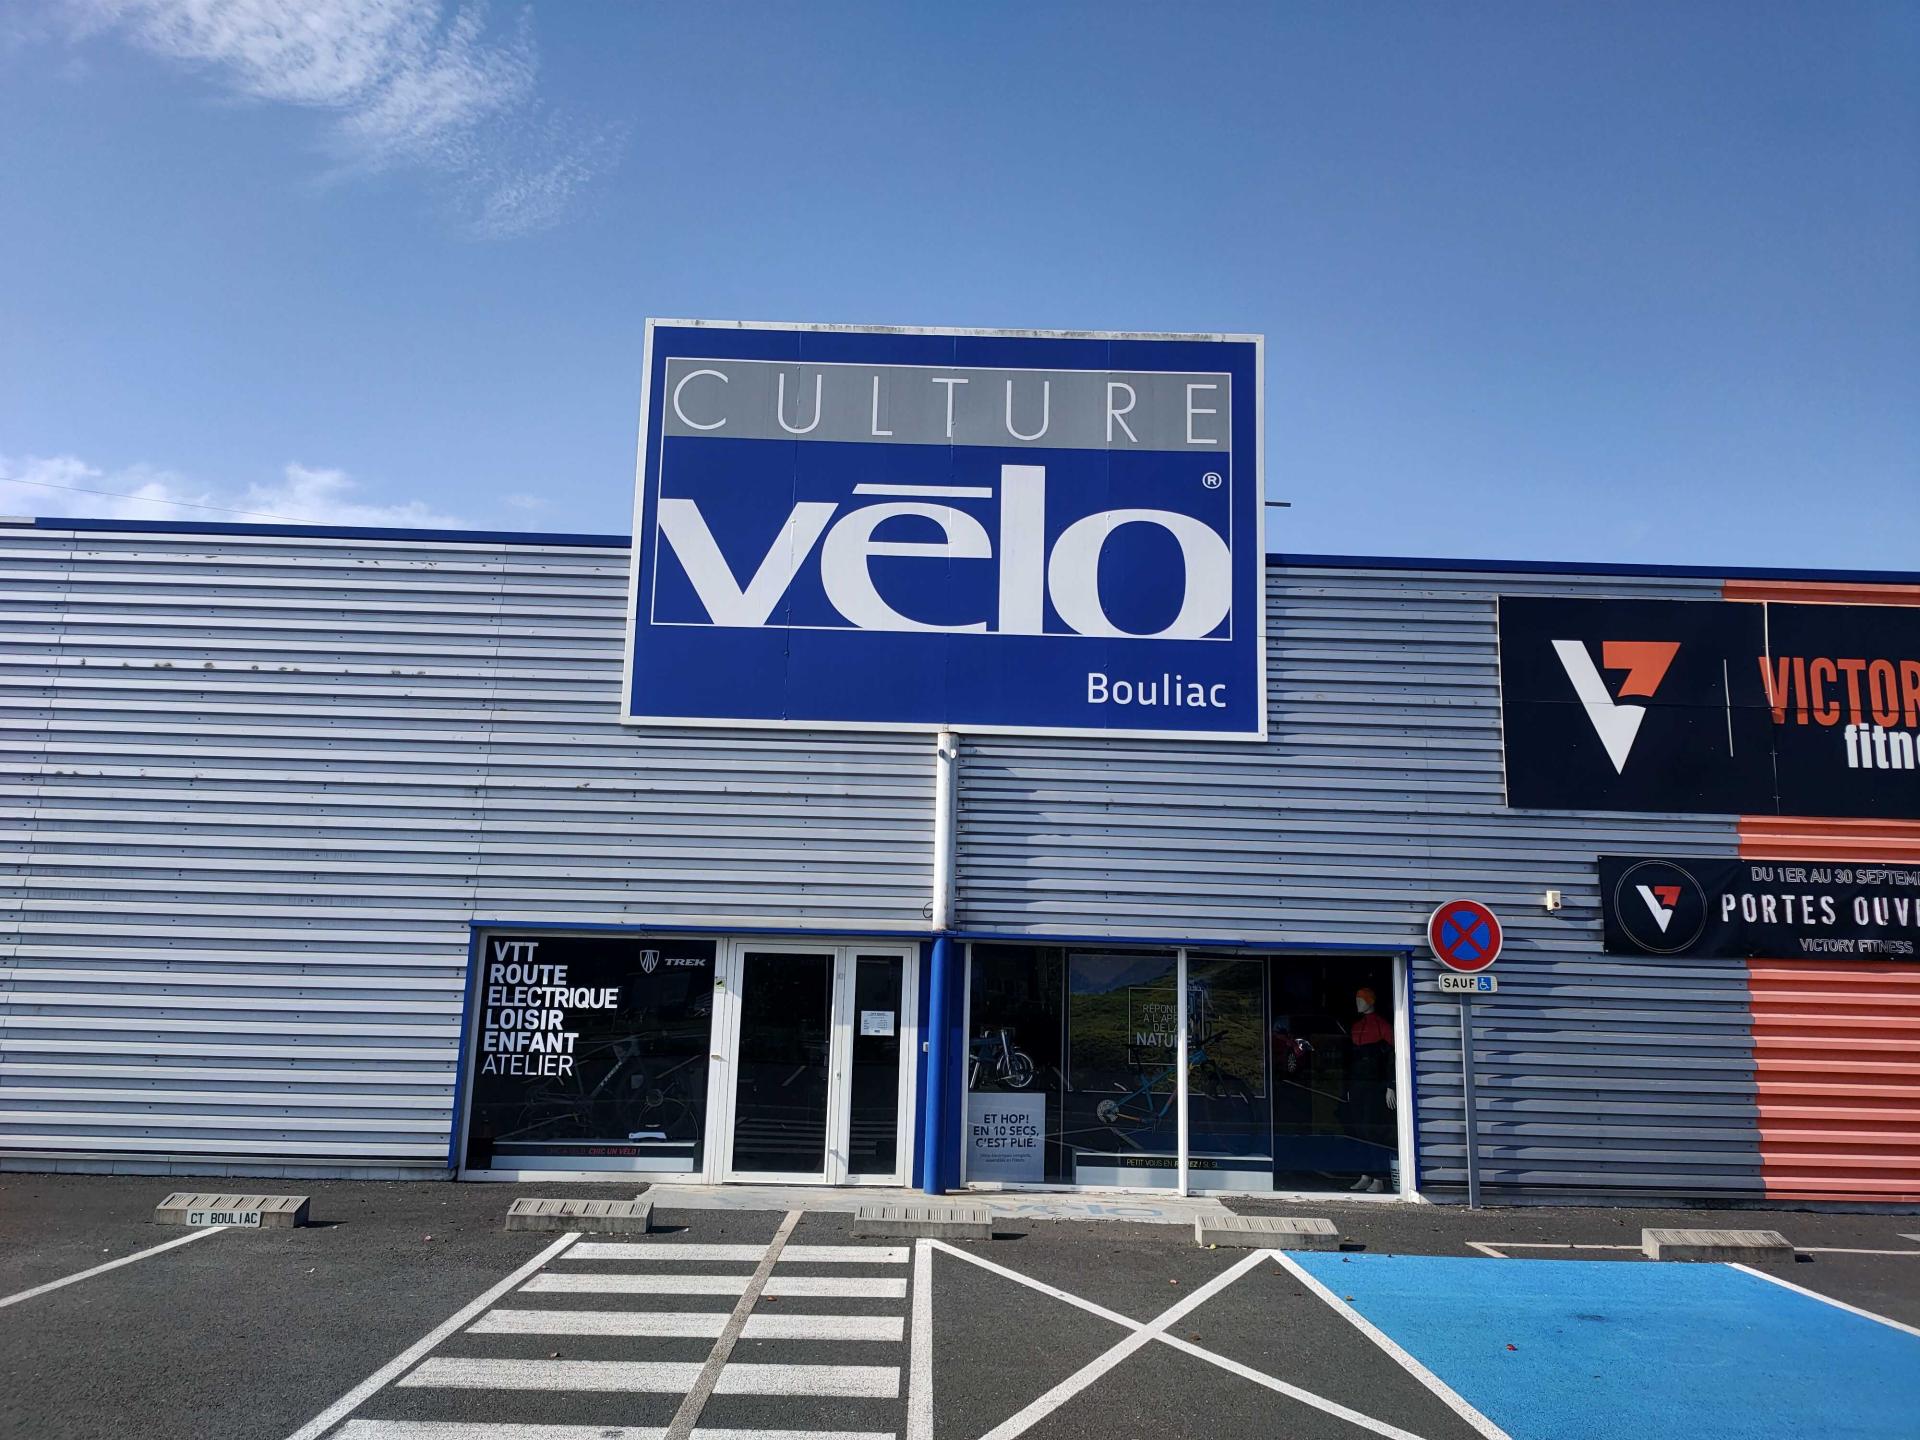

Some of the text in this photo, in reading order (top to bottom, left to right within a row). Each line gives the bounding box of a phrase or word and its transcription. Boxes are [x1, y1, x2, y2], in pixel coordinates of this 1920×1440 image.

[673, 369, 1218, 444] CULTURE
[1088, 672, 1227, 708] Bouliac
[1844, 723, 1920, 769] fitn
[1751, 866, 1920, 886] DU 1ER AU 30 SEPTEM
[1721, 893, 1837, 926] PORTES
[494, 941, 539, 962] VTT
[1799, 938, 1914, 954] VICTORY FITNESS
[664, 958, 706, 967] TREK
[489, 963, 568, 986] ROUTE
[1443, 977, 1476, 989] SAUF
[487, 986, 619, 1009] ELECTRIQUE
[485, 1008, 564, 1030] LOISIR
[1153, 1023, 1166, 1033] DE
[483, 1031, 579, 1053] ENFANT
[1136, 1032, 1194, 1049] NATUE
[481, 1054, 574, 1076] ATELIER
[983, 1114, 1029, 1124] ET HOP!
[973, 1126, 1040, 1137] EN 10 SECS,
[975, 1138, 1007, 1148] C'EST
[190, 1212, 258, 1224] CT BOULIAC
